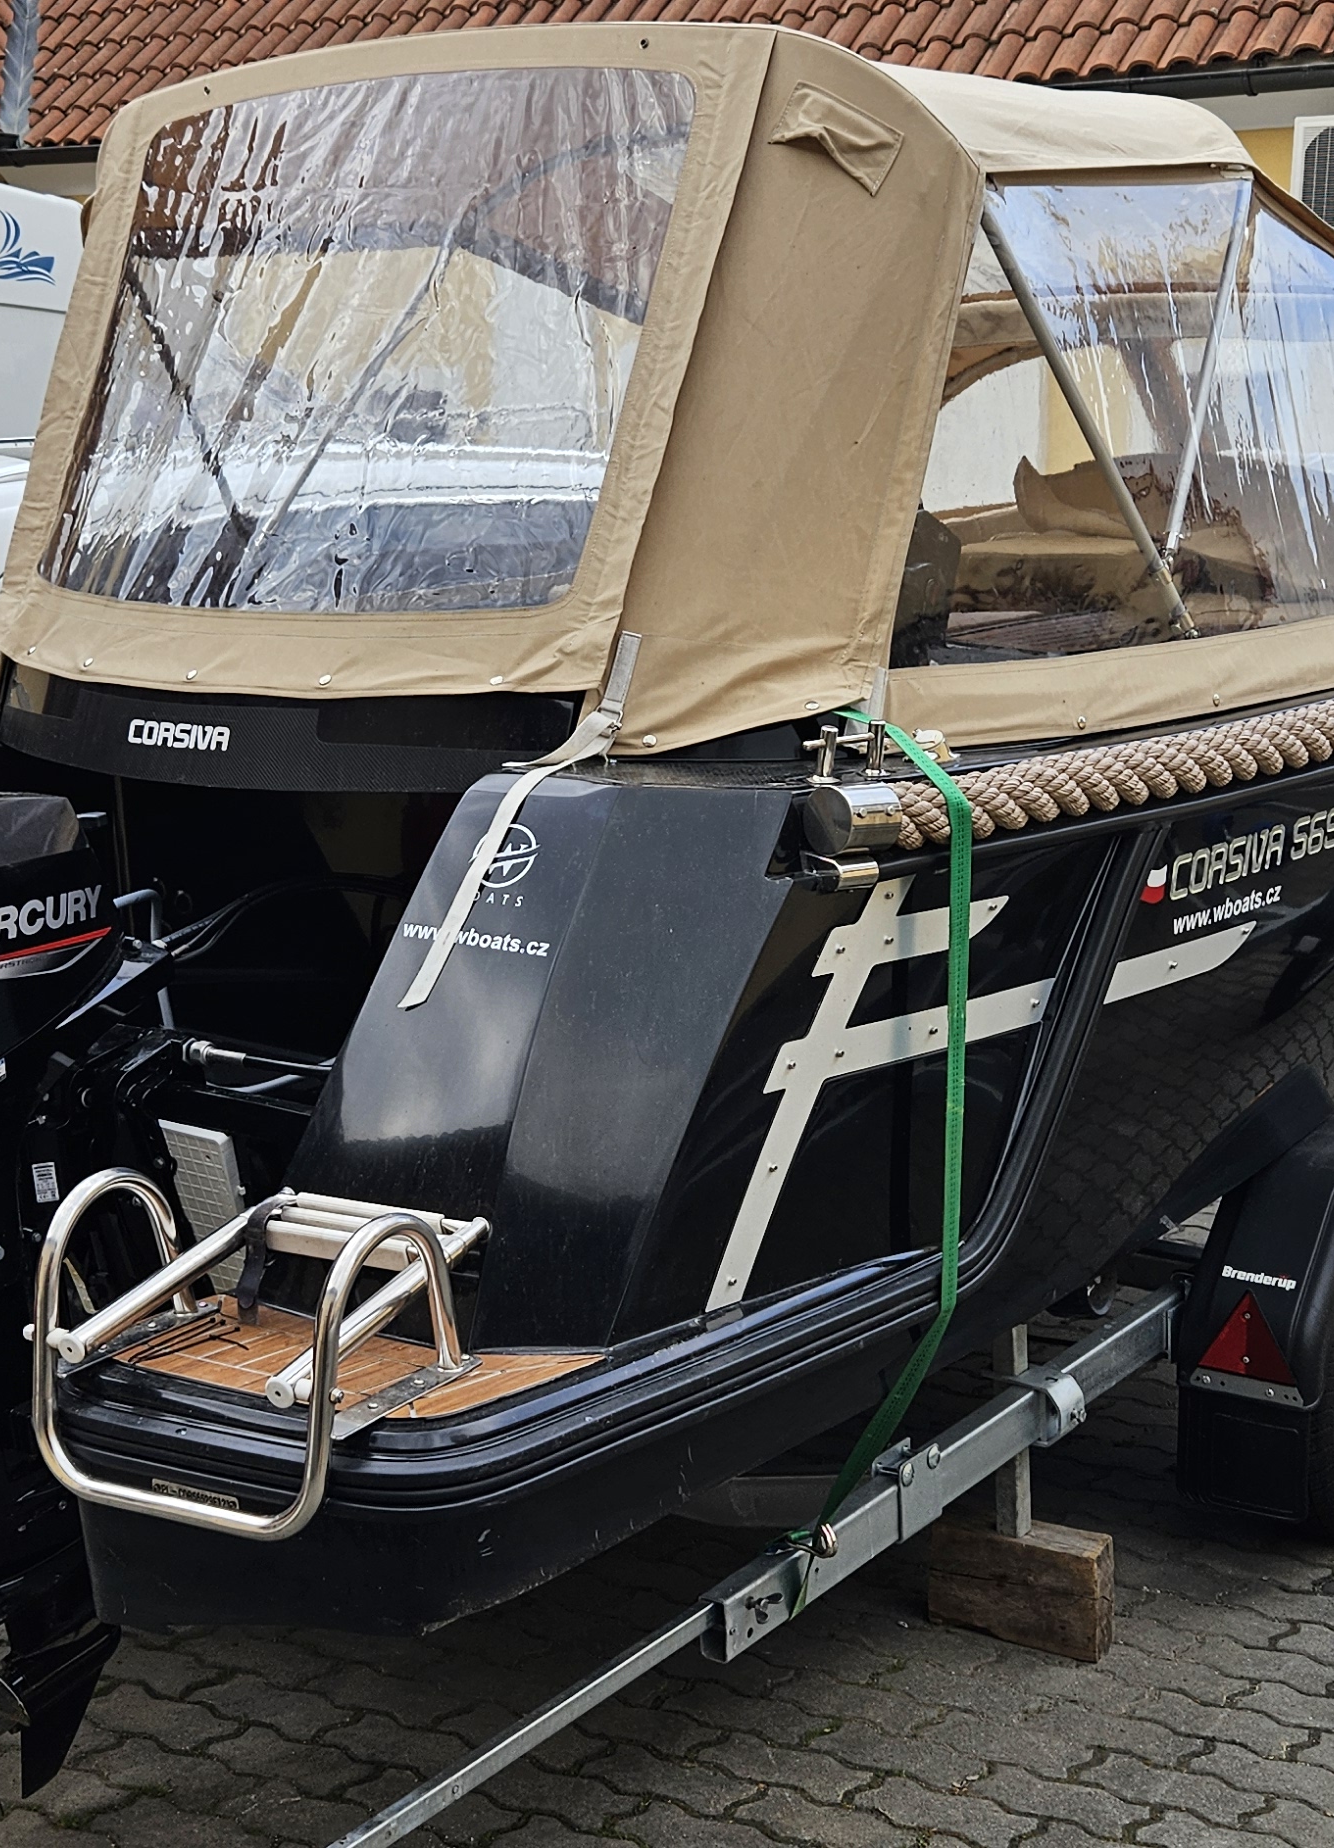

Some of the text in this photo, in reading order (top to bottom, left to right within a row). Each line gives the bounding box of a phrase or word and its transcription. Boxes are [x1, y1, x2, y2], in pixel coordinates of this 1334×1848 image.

[128, 718, 231, 752] CORSIVA
[1169, 823, 1286, 901] CORSIVA
[473, 890, 524, 907] OATS
[1172, 884, 1284, 936] www.wboats.cz
[1221, 1264, 1298, 1291] Brenderup
